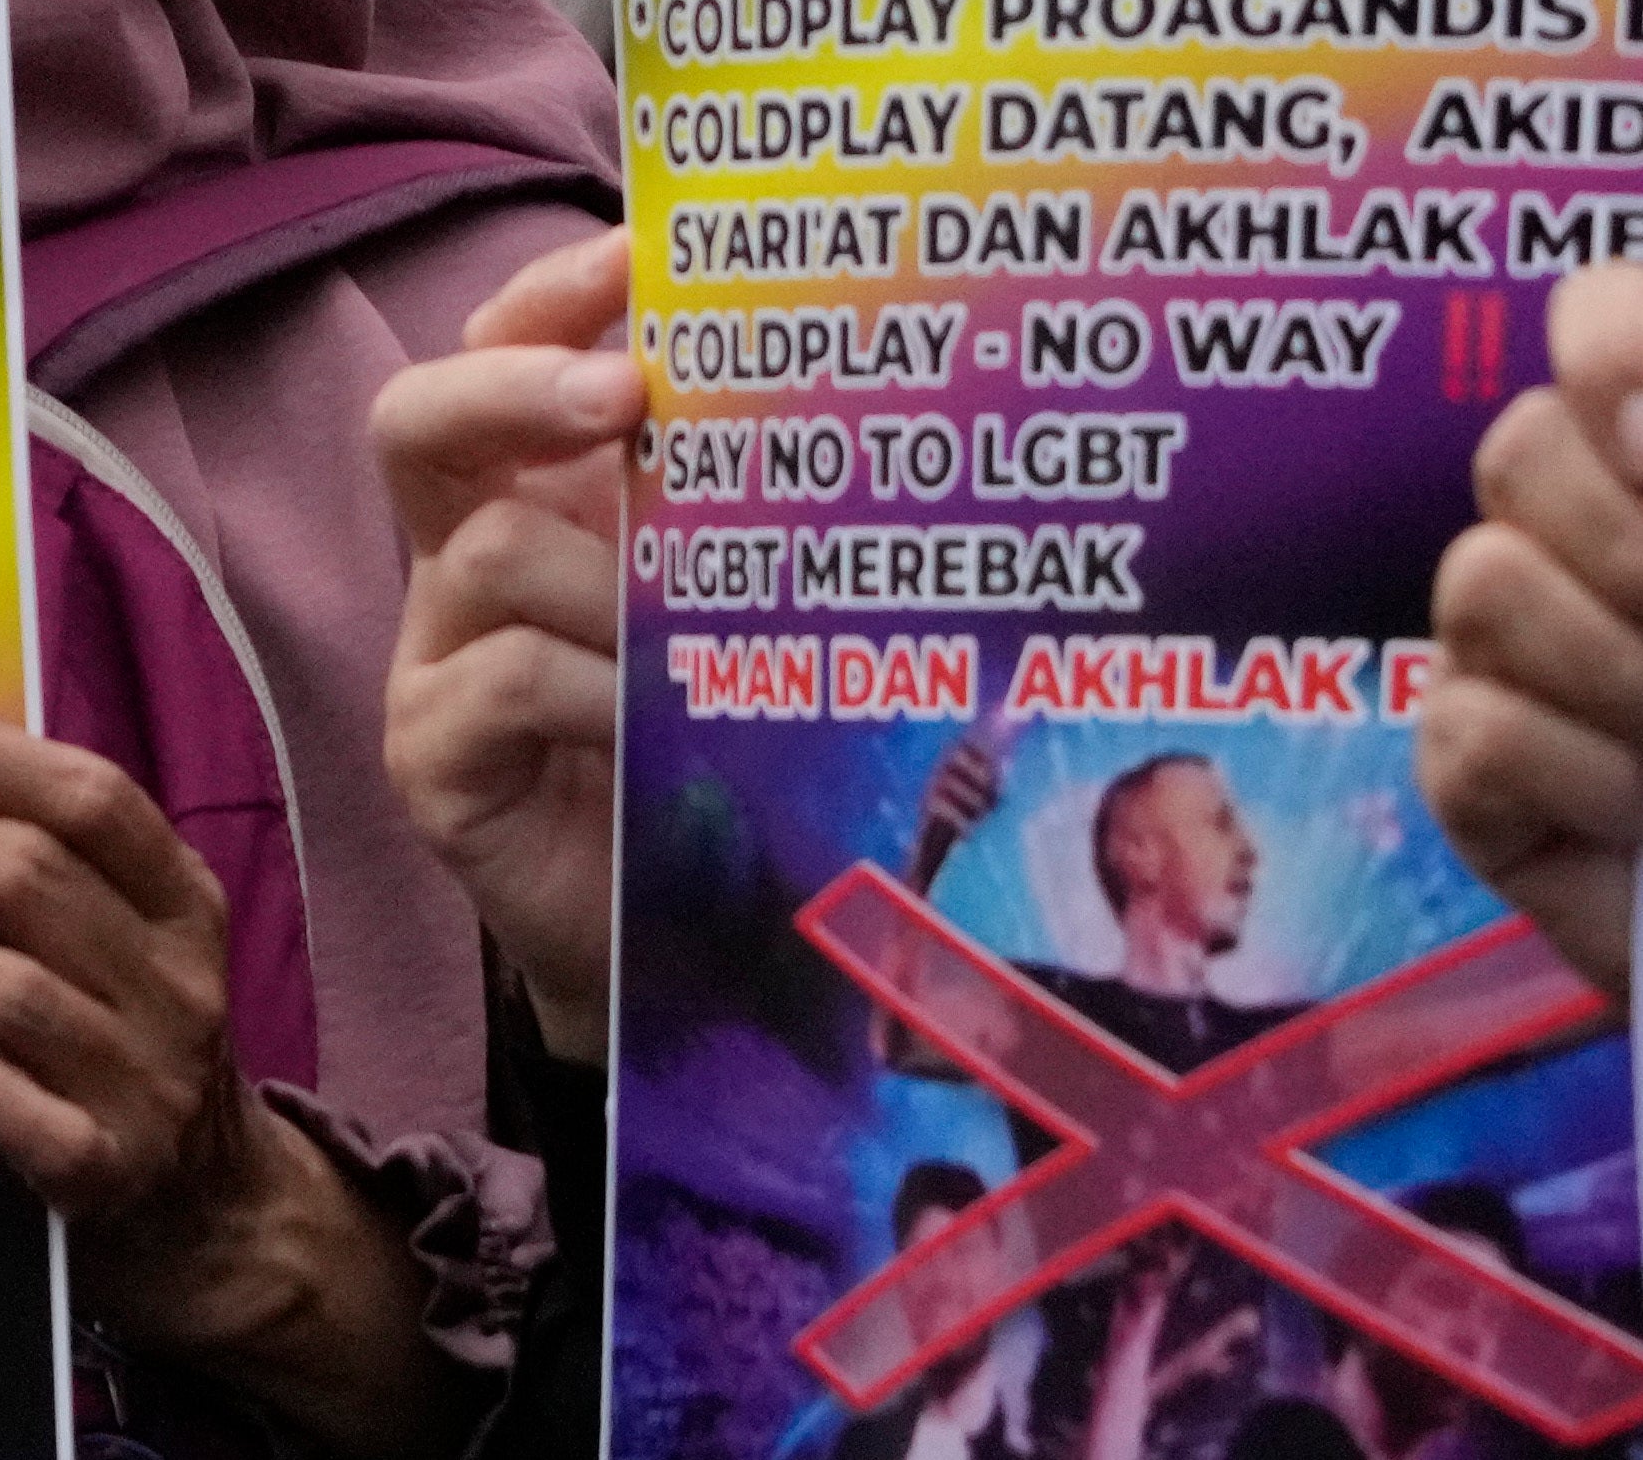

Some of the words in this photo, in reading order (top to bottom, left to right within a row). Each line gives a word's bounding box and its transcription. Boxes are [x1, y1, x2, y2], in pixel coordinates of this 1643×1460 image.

[659, 83, 969, 172] COLDPLAY
[982, 78, 1369, 178] DATANG,
[670, 196, 905, 280] SYARI'AT
[920, 191, 1091, 274] DAN
[1101, 187, 1496, 277] AKHLAK
[659, 302, 967, 390] COLDPLAY
[1020, 302, 1151, 387] NO
[1165, 298, 1402, 387] WAY
[662, 417, 753, 502] SAY
[761, 415, 849, 497] NO
[860, 414, 964, 497] TO
[971, 411, 1188, 499] LGBT
[664, 525, 787, 611] LGBT
[792, 524, 1144, 612] MEREBAK
[829, 635, 973, 721] DAN
[1003, 635, 1370, 722] AKHLAK
